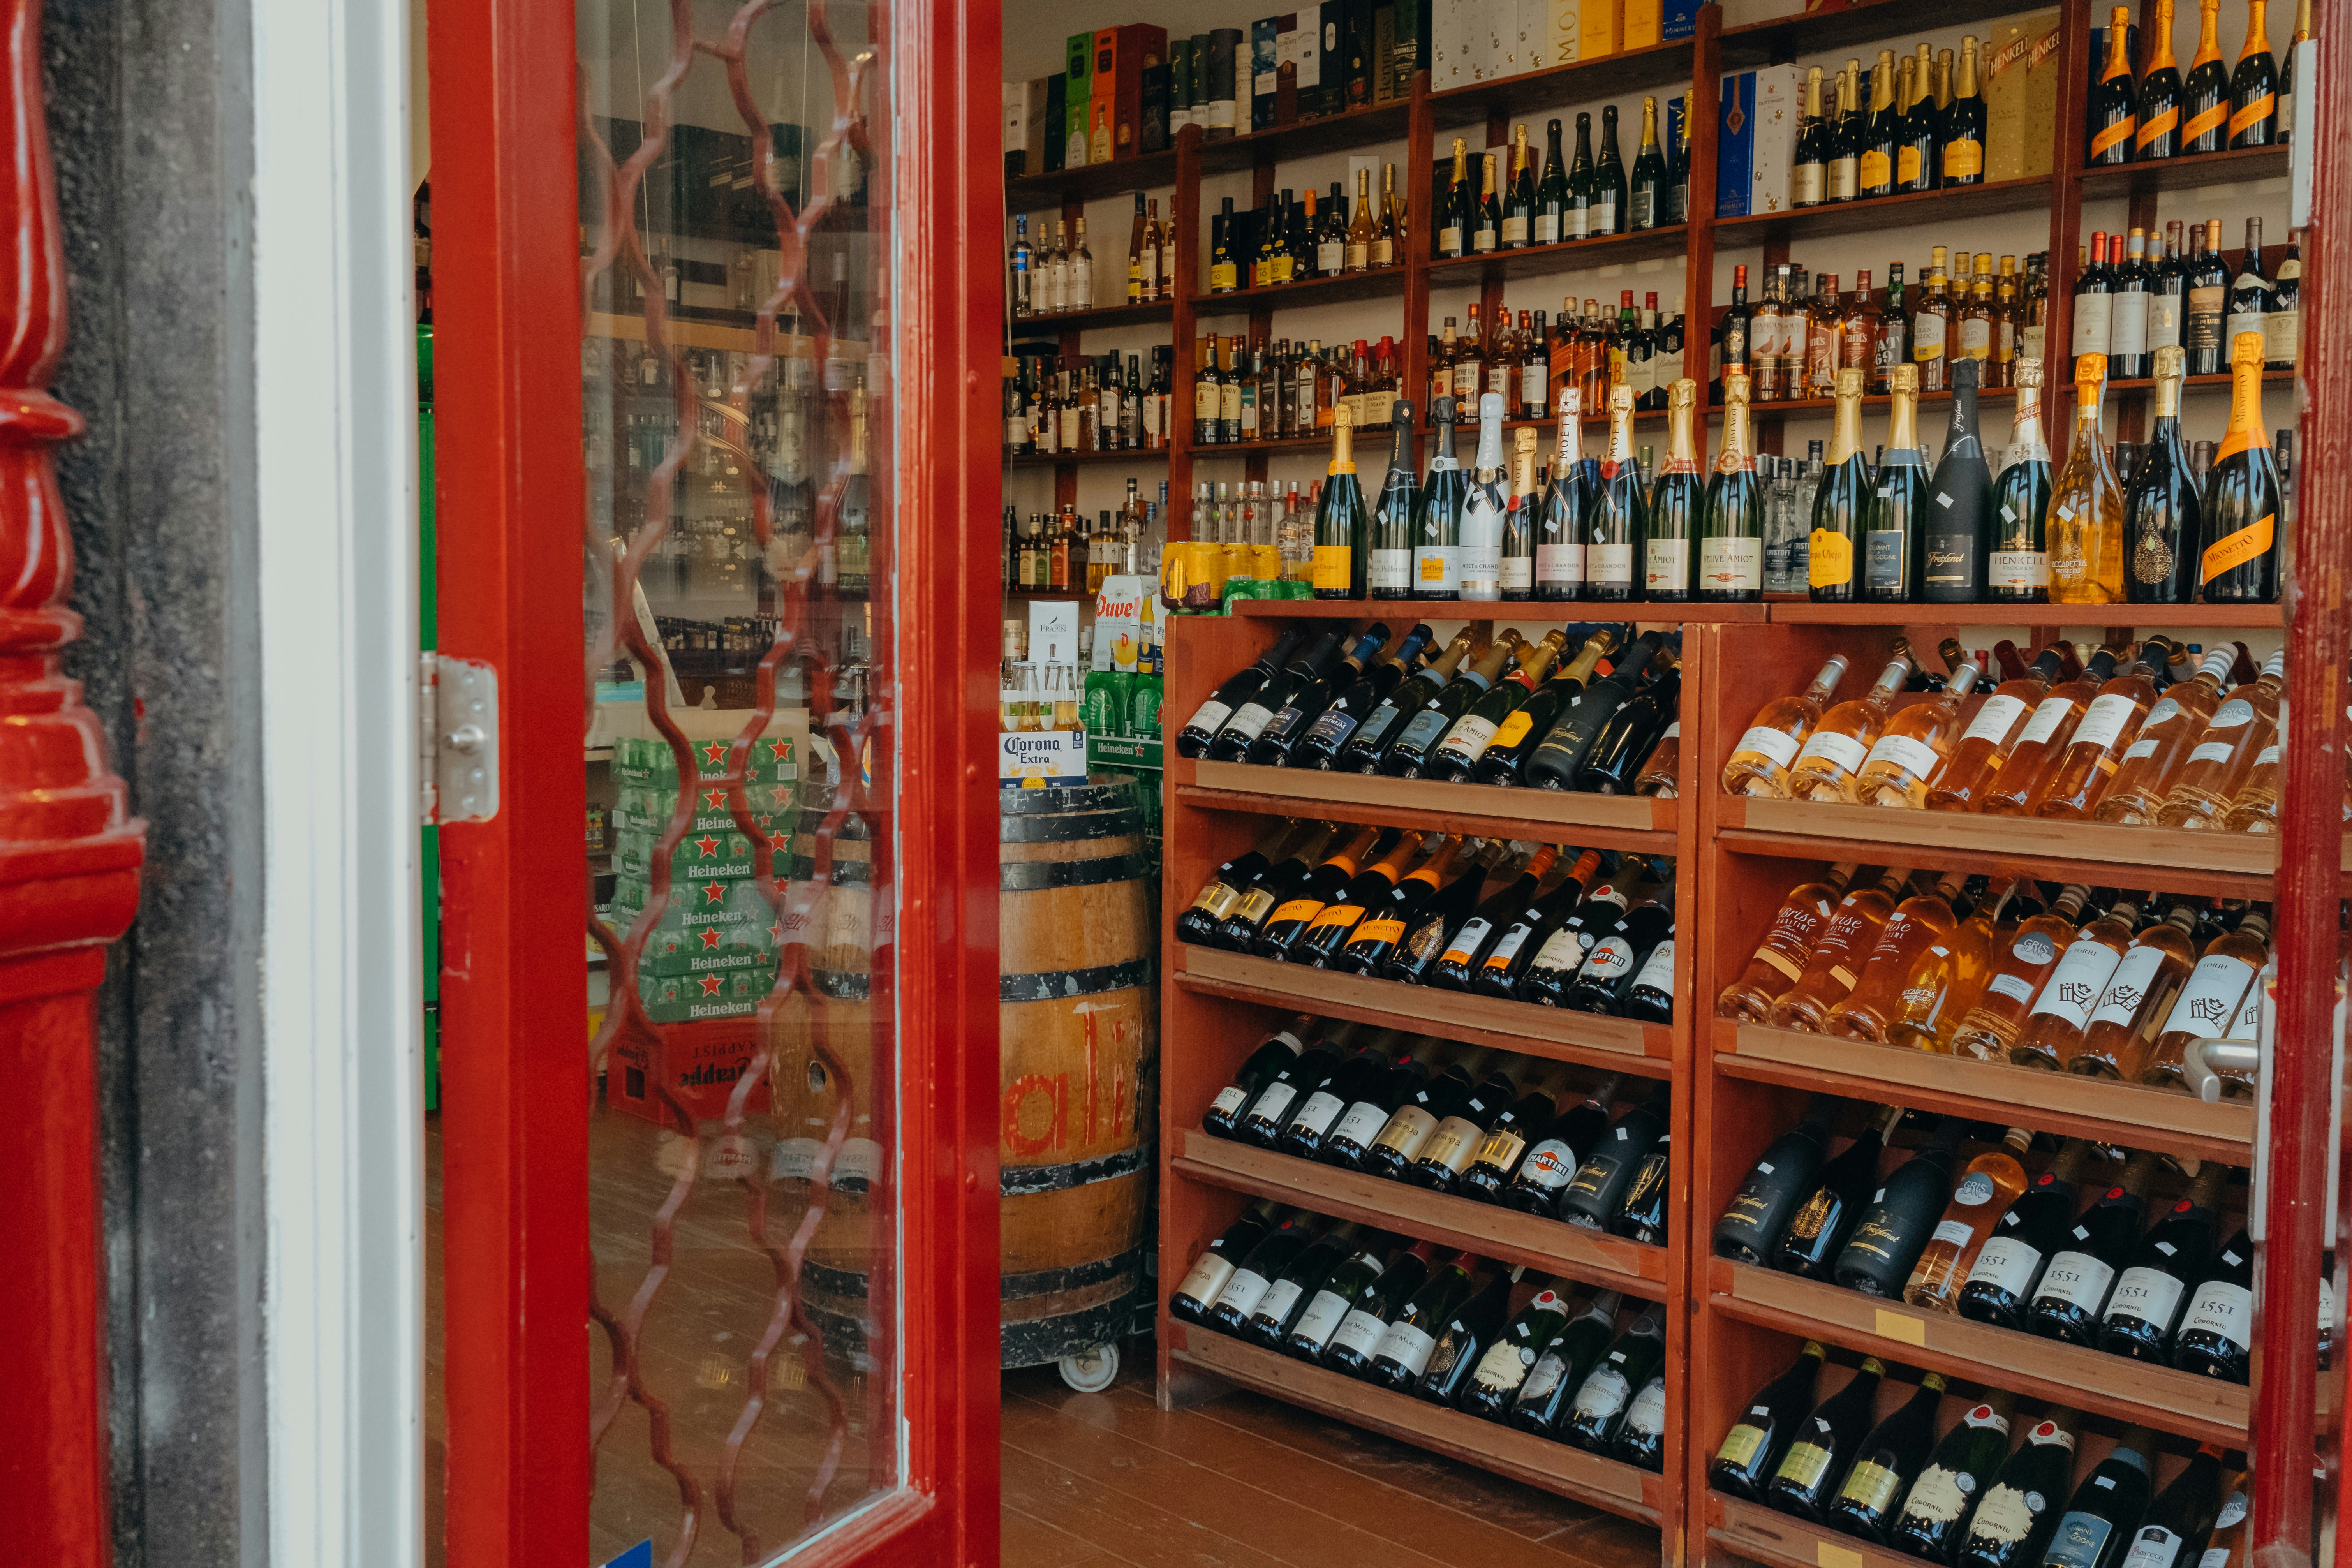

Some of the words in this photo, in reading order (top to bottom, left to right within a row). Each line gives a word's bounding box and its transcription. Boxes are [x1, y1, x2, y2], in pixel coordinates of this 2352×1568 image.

[1665, 25, 1695, 34] POMMERY
[1758, 97, 1784, 106] TAITTINGER
[1845, 333, 1867, 344] rant's
[1877, 336, 1899, 351] AT
[1875, 351, 1892, 365] 69
[2235, 374, 2248, 423] MIONETTO
[1954, 399, 1963, 432] Freixenet
[1823, 550, 1841, 560] Viejo
[2208, 534, 2253, 563] MIONETTO
[1653, 555, 1676, 564] AMIOT
[1704, 555, 1725, 564] VEUVE
[1728, 555, 1753, 563] AMIOT
[1926, 552, 1964, 568] Freixenet
[1994, 556, 2045, 566] HENKELL
[1097, 595, 1140, 617] Duvel
[1122, 633, 1128, 647] D
[1464, 726, 1487, 741] AMIOT
[1550, 727, 1582, 742] Freixenet
[1004, 736, 1060, 756] Corona
[1098, 743, 1133, 755] Heineken
[1020, 753, 1049, 764] Extra
[697, 819, 737, 830] Heine
[689, 864, 750, 877] Heineken
[682, 911, 742, 925] Heineken
[1782, 907, 1817, 927] Brise
[1831, 916, 1862, 928] rise
[2021, 945, 2046, 959] BLANC
[2024, 939, 2049, 953] GRIS
[2074, 949, 2096, 957] TORRI
[691, 955, 751, 970] Heineken
[690, 1002, 751, 1017] Heineken
[692, 1041, 755, 1058] RAPPIST
[1529, 1154, 1569, 1176] MARTINI
[1960, 1188, 1984, 1199] BLANC
[1964, 1181, 1987, 1193] GRIS
[1858, 1223, 1900, 1242] Freixenet
[1980, 1255, 2008, 1266] 1551
[1973, 1270, 1998, 1279] CODORNÍU
[2050, 1270, 2082, 1283] 1551
[2044, 1285, 2073, 1296] CODORNÍU
[2119, 1287, 2149, 1298] 1551
[2112, 1302, 2141, 1312] CODORNÍU
[2200, 1301, 2235, 1314] 1551
[2194, 1316, 2226, 1329] CODORNÍU
[1353, 1323, 1376, 1338] MARCAL
[1399, 1335, 1422, 1353] MARCAL
[1481, 1367, 1506, 1381] CODORNÍU
[1911, 1496, 1943, 1513] CODORNÍU
[1977, 1517, 2010, 1534] CODORNÍU
[2131, 1545, 2163, 1561] PROSECCO
